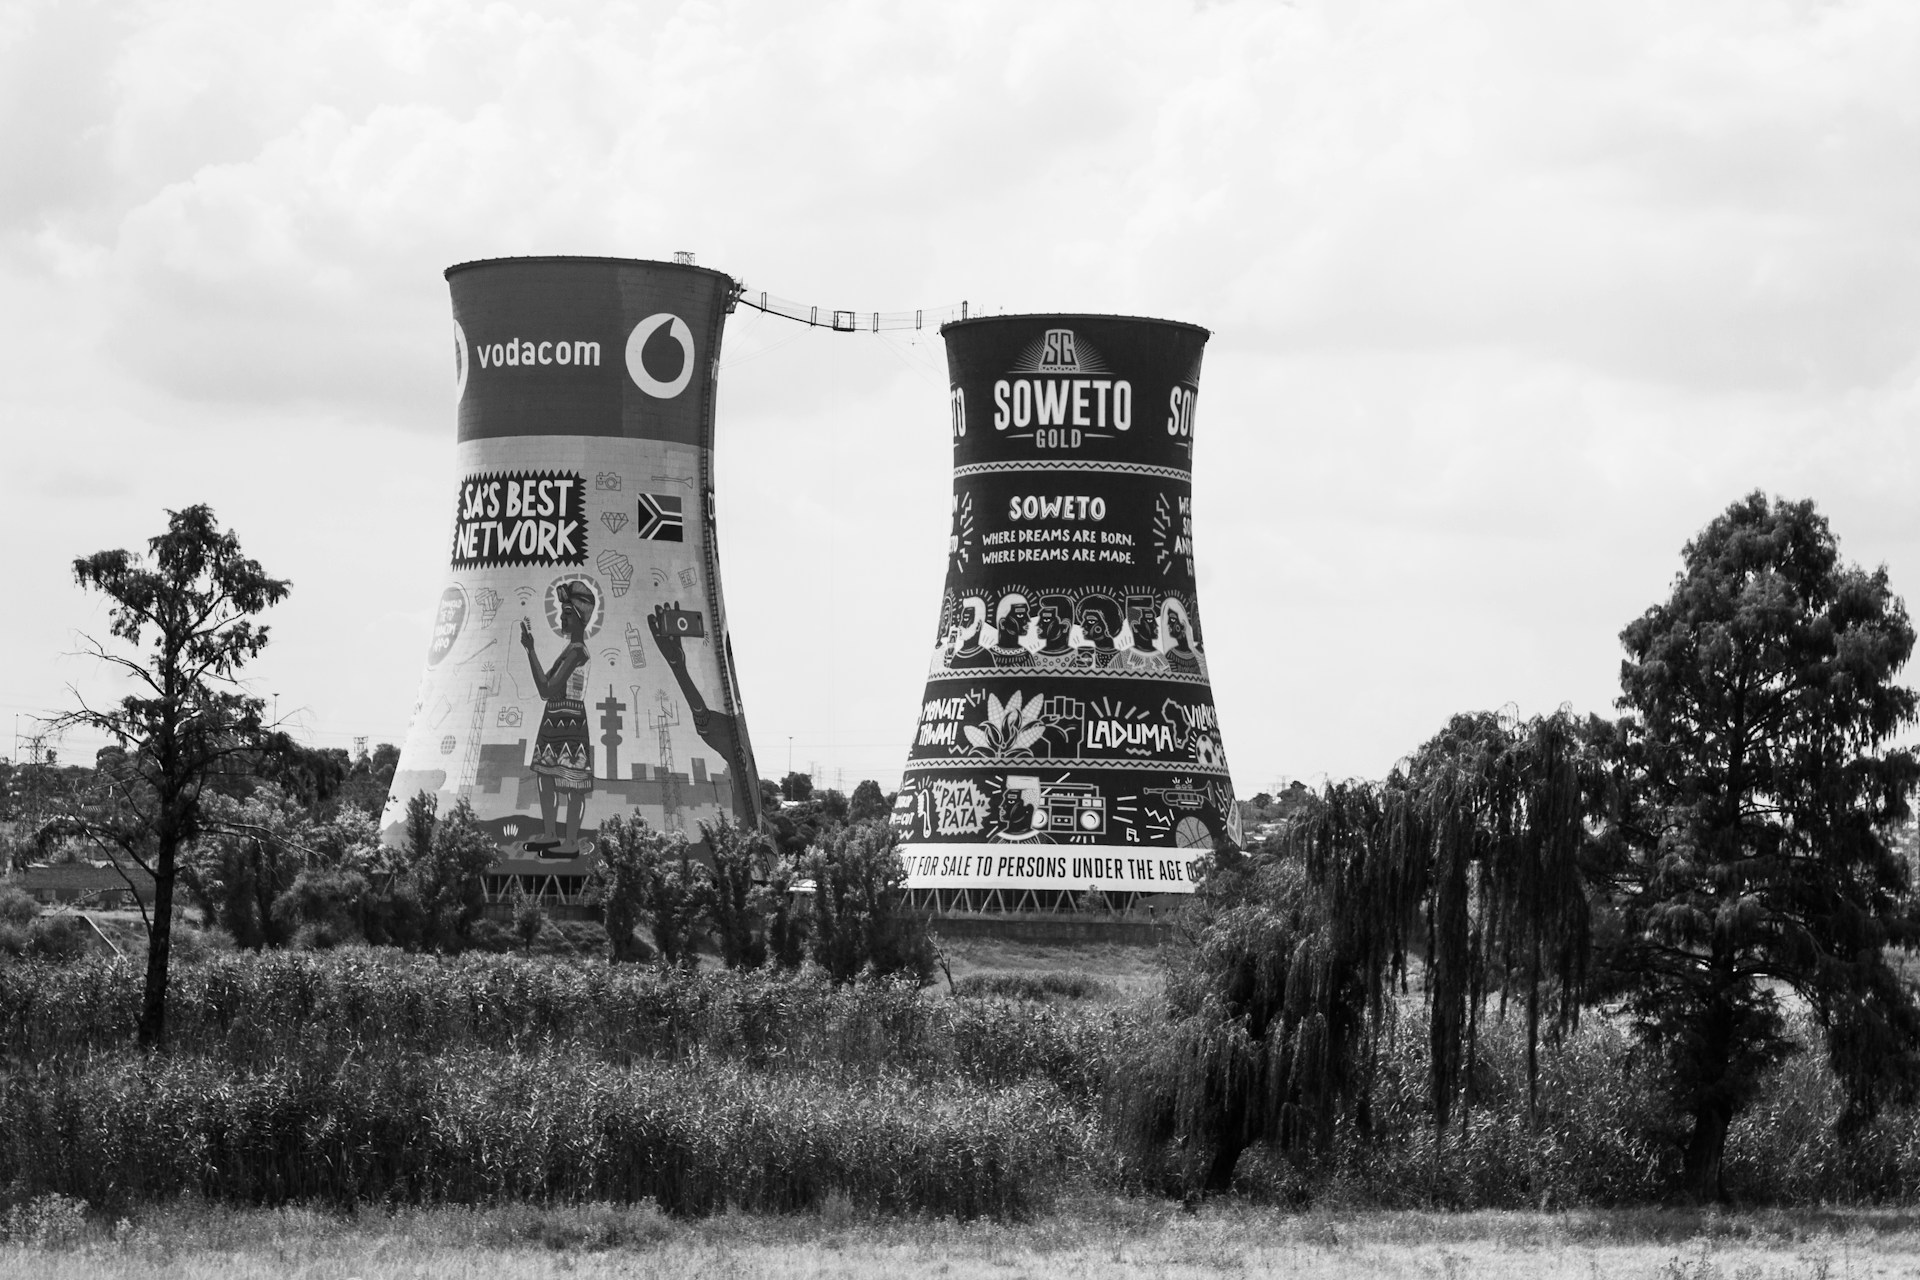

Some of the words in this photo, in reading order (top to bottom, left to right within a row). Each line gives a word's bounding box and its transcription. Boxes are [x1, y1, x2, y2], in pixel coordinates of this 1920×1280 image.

[476, 337, 600, 369] vodacom
[994, 379, 1132, 431] SOWETO
[1036, 429, 1082, 448] GOLD
[463, 482, 501, 520] SA'S
[506, 480, 574, 517] BEST
[1008, 495, 1106, 521] SOWETO
[456, 519, 579, 560] NETWORK
[982, 530, 1016, 546] WHERE
[1018, 529, 1070, 543] DREAMS
[1072, 530, 1096, 543] ARE
[1100, 531, 1136, 546] BORN.
[982, 549, 1016, 565] WHERE
[1018, 549, 1069, 562] DREAMS
[1072, 549, 1096, 562] ARE
[1099, 550, 1135, 565] MADE.
[1087, 720, 1174, 752] LADUMA
[917, 856, 939, 876] FOR
[941, 856, 972, 876] SALE
[976, 856, 993, 877] TO
[998, 856, 1066, 878] PERSONS
[1073, 857, 1124, 879] UNDER
[1128, 858, 1154, 880] THE
[1160, 860, 1183, 881] AGE
